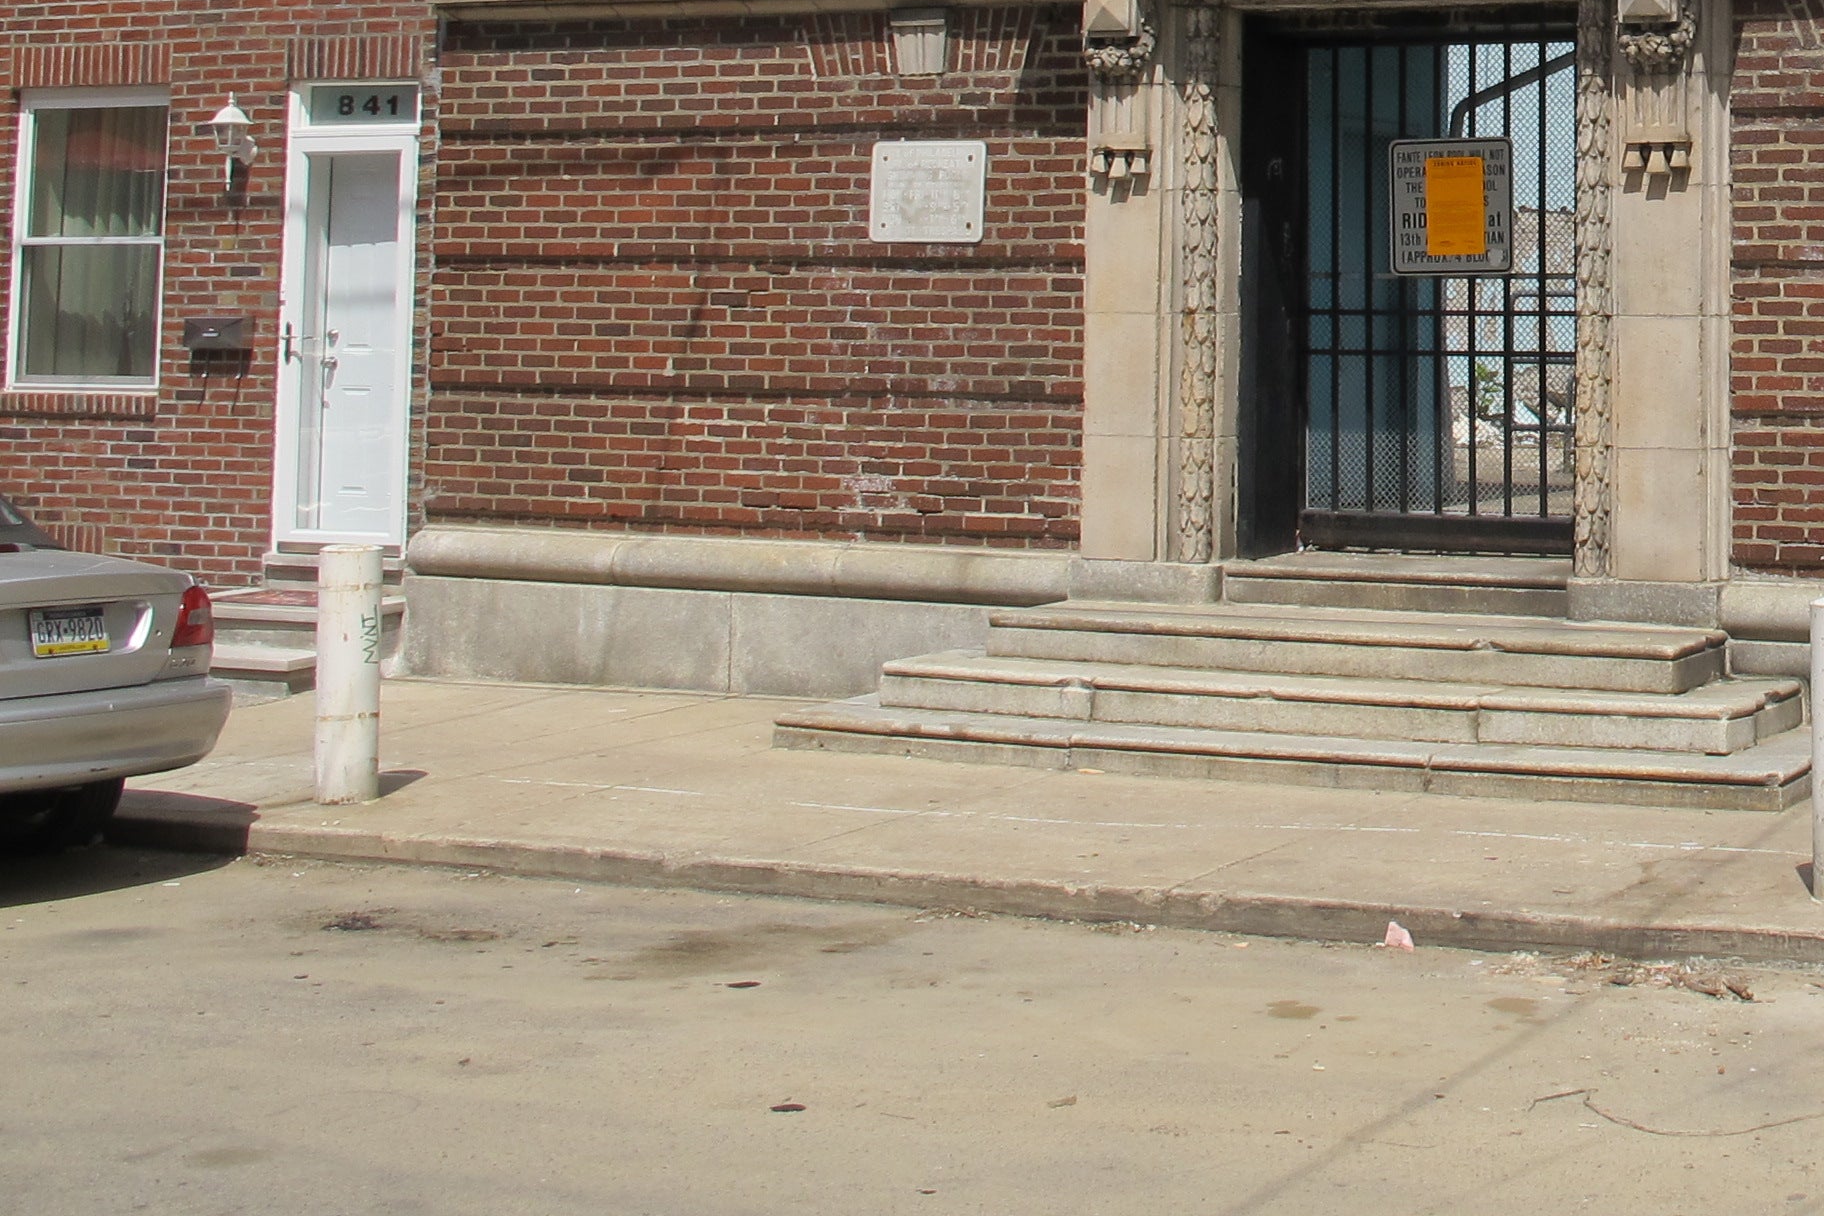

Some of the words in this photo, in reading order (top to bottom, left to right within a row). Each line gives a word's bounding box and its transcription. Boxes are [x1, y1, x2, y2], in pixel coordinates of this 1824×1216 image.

[338, 94, 399, 116] 841
[1489, 148, 1504, 160] NOT
[1396, 167, 1427, 179] OPERA
[1406, 181, 1423, 193] THE
[1488, 211, 1501, 227] at
[1400, 232, 1421, 246] 13th
